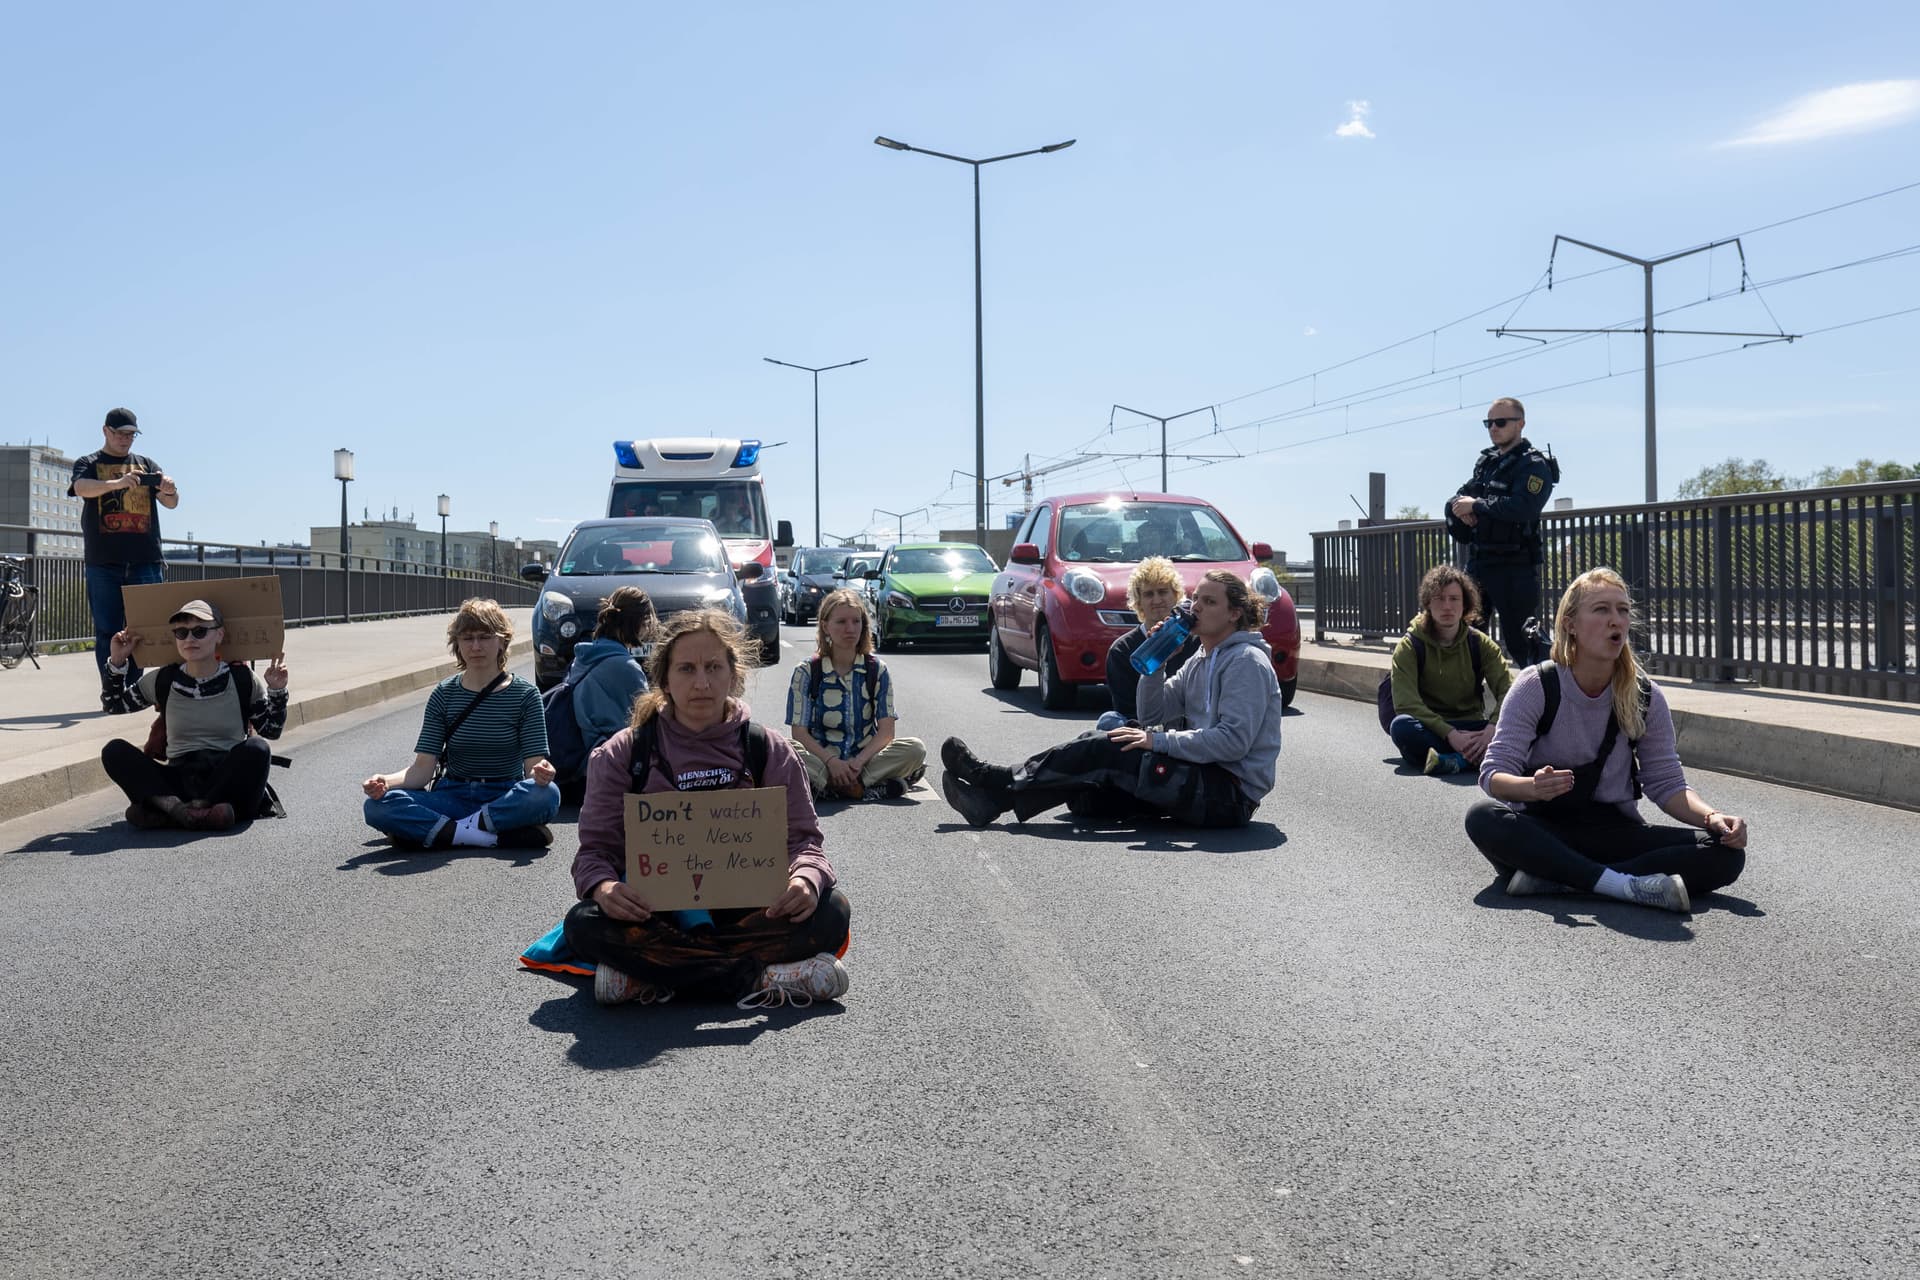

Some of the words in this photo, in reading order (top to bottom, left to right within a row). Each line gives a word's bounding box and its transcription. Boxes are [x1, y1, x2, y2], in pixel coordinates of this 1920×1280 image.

[678, 779, 717, 790] GEGEN
[719, 773, 734, 784] ÖL
[638, 801, 693, 822] Don't
[709, 801, 761, 820] watch
[652, 828, 685, 846] the
[706, 827, 753, 844] News
[638, 853, 669, 877] Be
[682, 853, 713, 871] the
[726, 852, 776, 870] News
